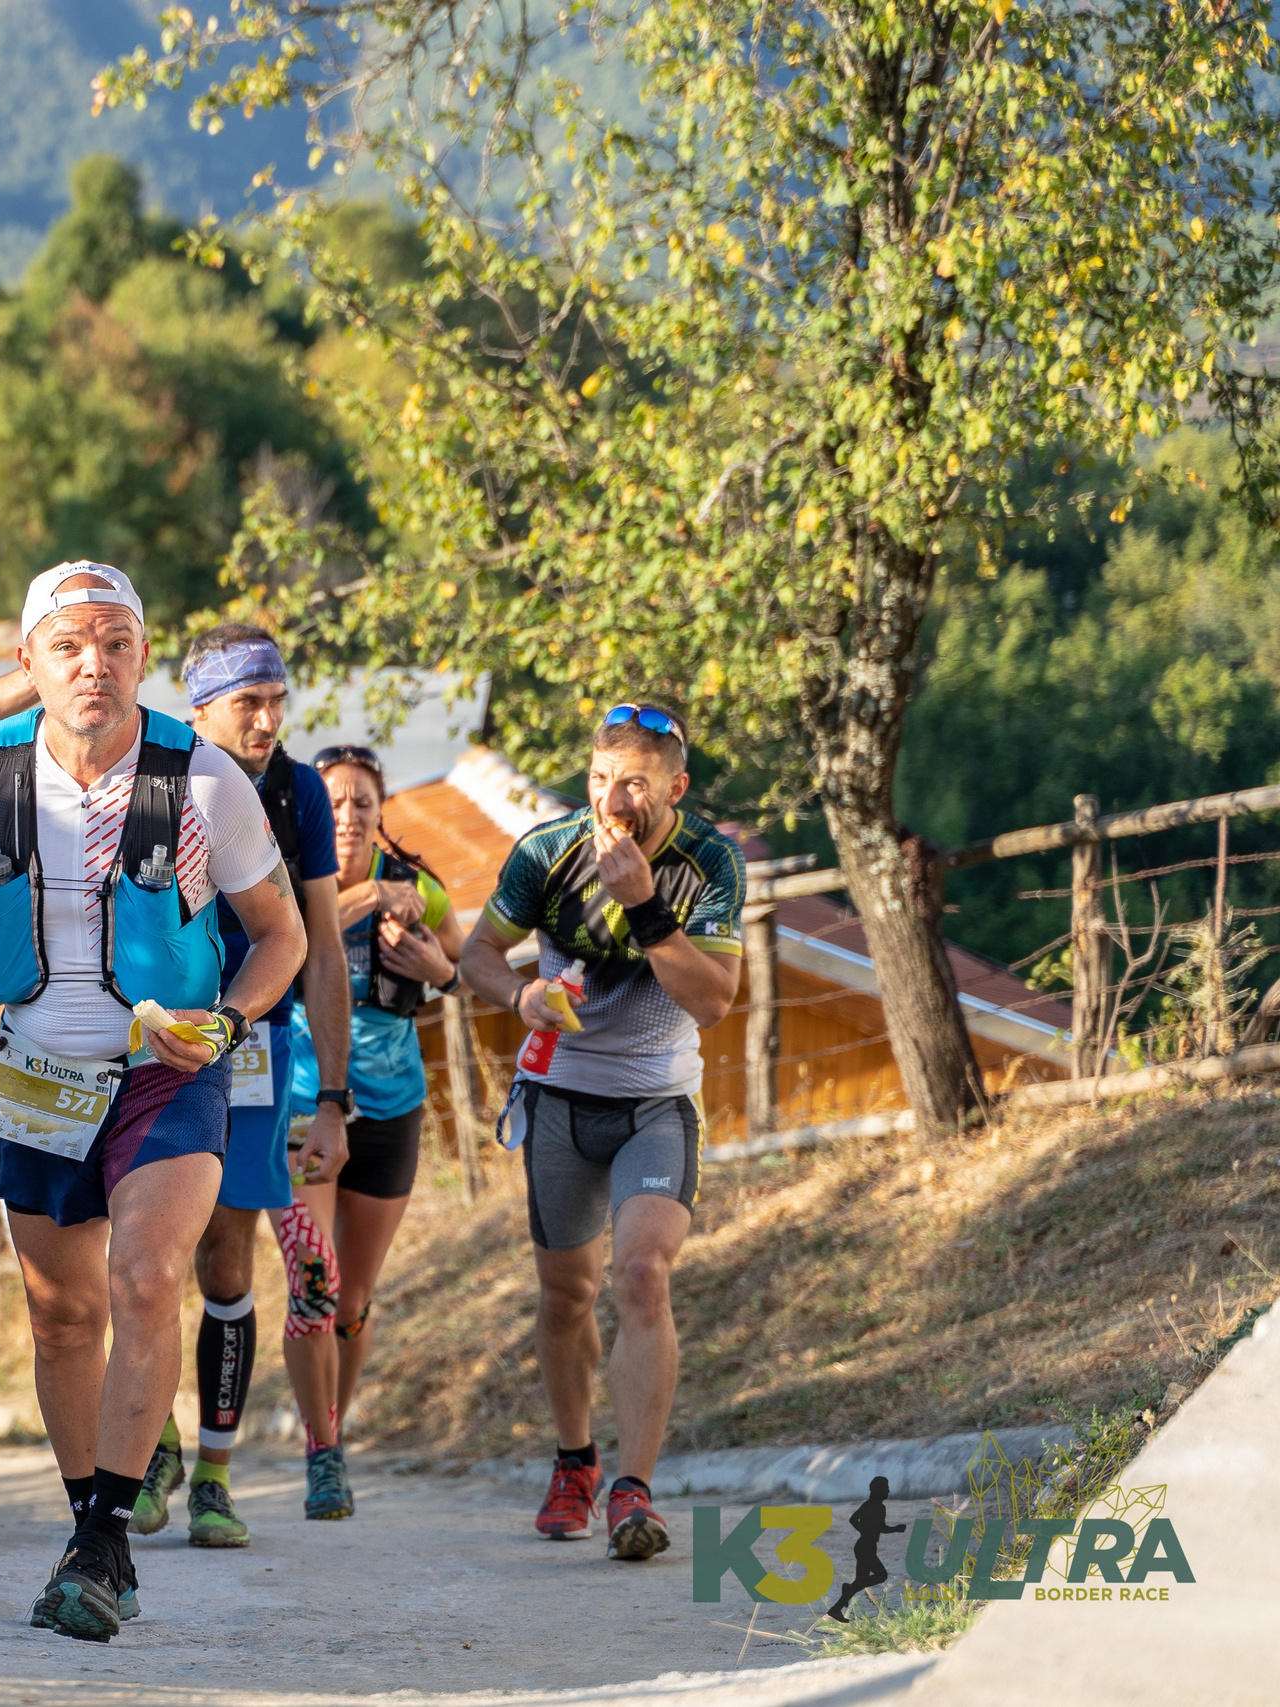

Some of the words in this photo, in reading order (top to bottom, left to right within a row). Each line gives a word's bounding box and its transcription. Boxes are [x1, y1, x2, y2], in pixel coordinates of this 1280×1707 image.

[705, 921, 729, 936] K3
[26, 1056, 42, 1073] K3
[49, 1066, 85, 1083] ULTRA
[55, 1087, 97, 1115] 571
